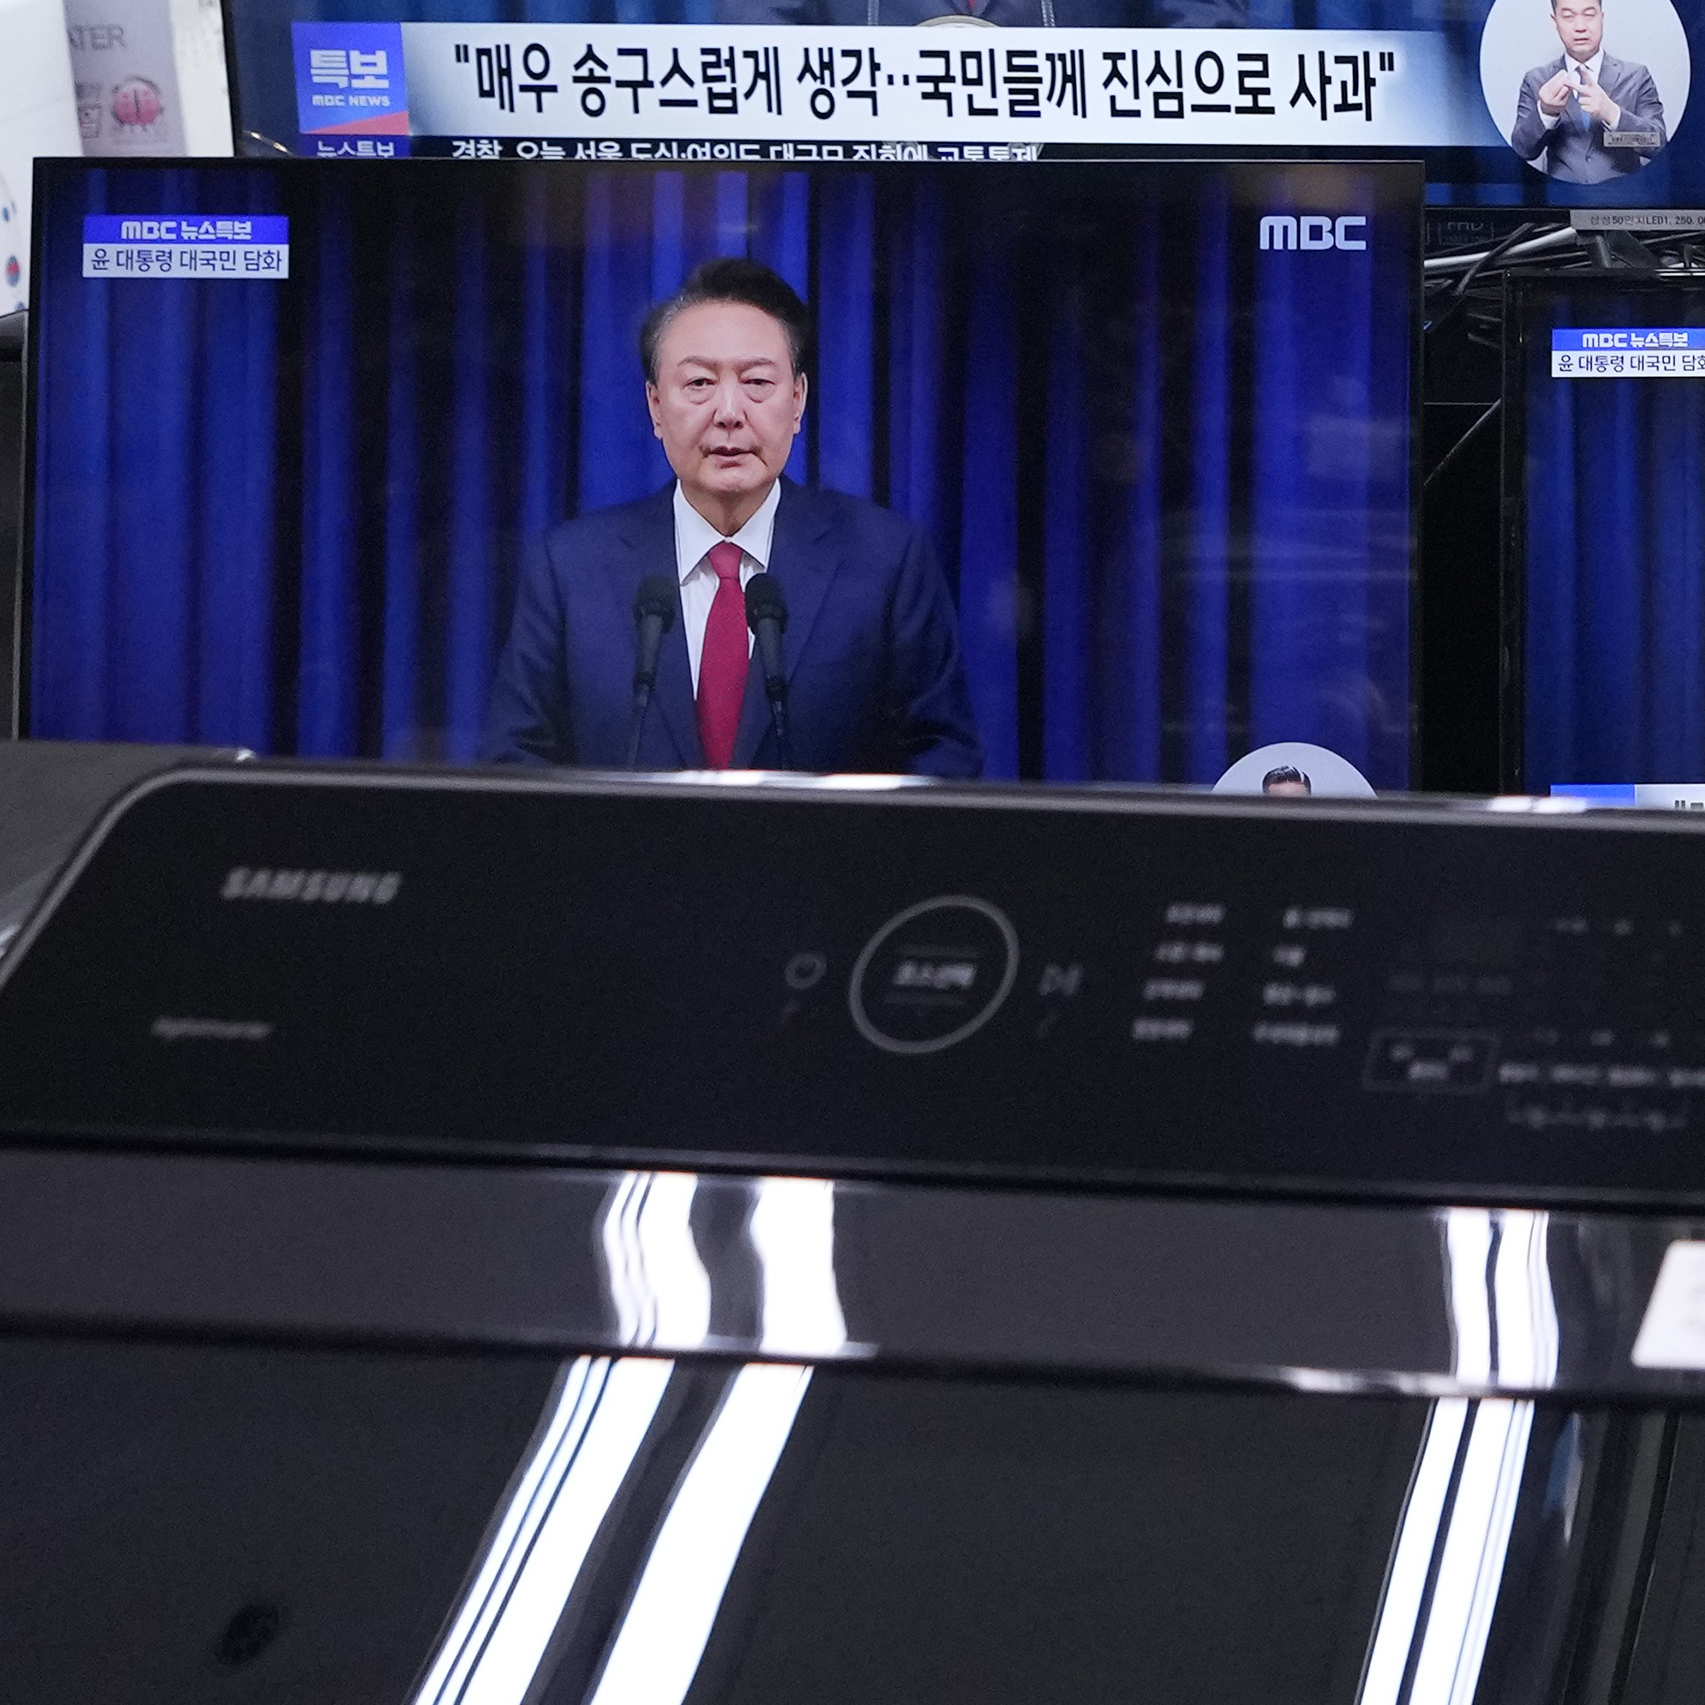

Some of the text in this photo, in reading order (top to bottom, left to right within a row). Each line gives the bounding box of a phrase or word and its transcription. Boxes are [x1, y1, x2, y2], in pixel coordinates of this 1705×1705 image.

[310, 49, 389, 91] 특보
[454, 43, 558, 117] "매우
[571, 43, 783, 119] 송구스럽게
[1102, 50, 1275, 120] 진심으로
[1290, 51, 1394, 123] 사과"
[312, 95, 391, 107] MBC NEWS
[121, 221, 252, 241] MBC 뉴스특보
[1260, 216, 1366, 251] MBC
[91, 248, 282, 273] 윤 대통령 대국민 담화
[1582, 332, 1688, 347] MBC 뉴스특보
[1558, 355, 1573, 372] 윤
[1579, 355, 1624, 372] 대통령
[1630, 355, 1676, 371] 대국민
[222, 867, 400, 905] SAMSUNG
